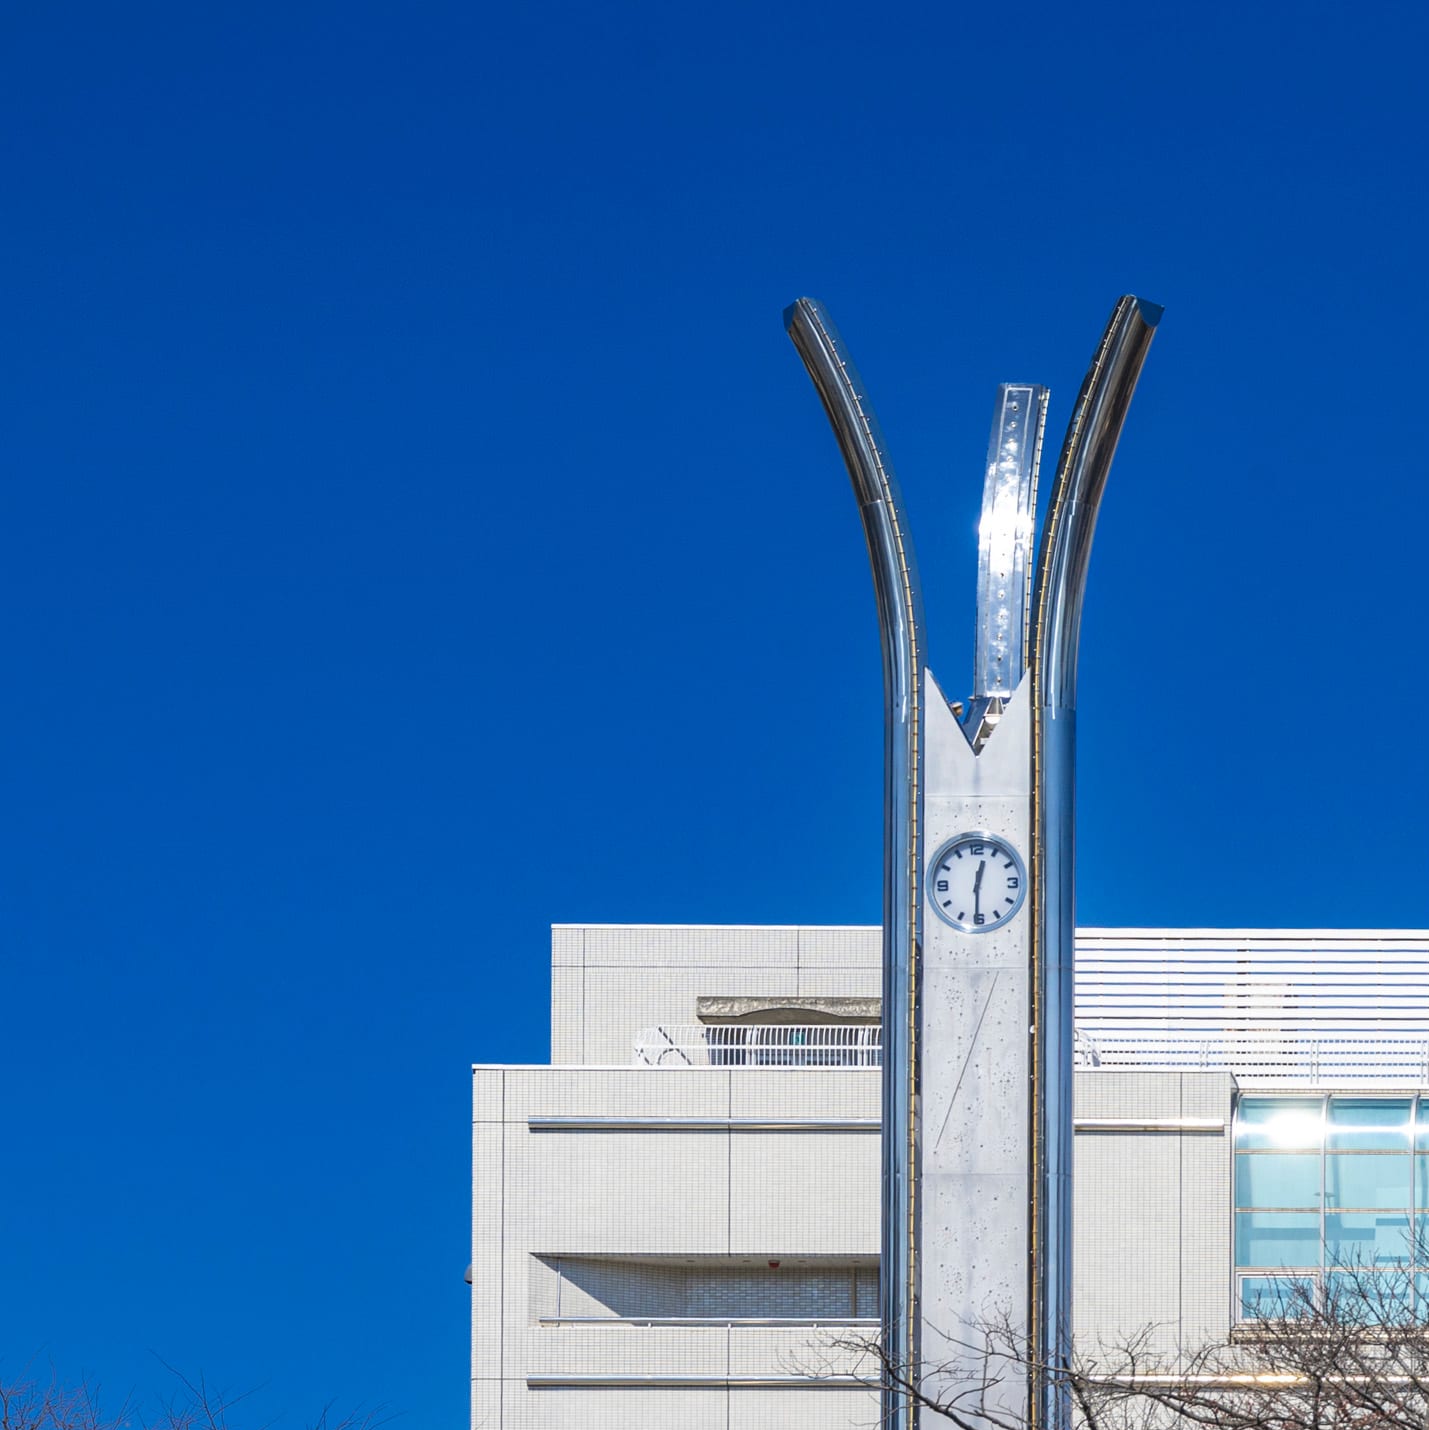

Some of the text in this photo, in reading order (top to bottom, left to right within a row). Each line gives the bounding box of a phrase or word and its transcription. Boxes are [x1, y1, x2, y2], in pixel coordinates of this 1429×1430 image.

[970, 844, 984, 855] 12
[937, 880, 949, 892] 9
[1007, 877, 1019, 889] 3
